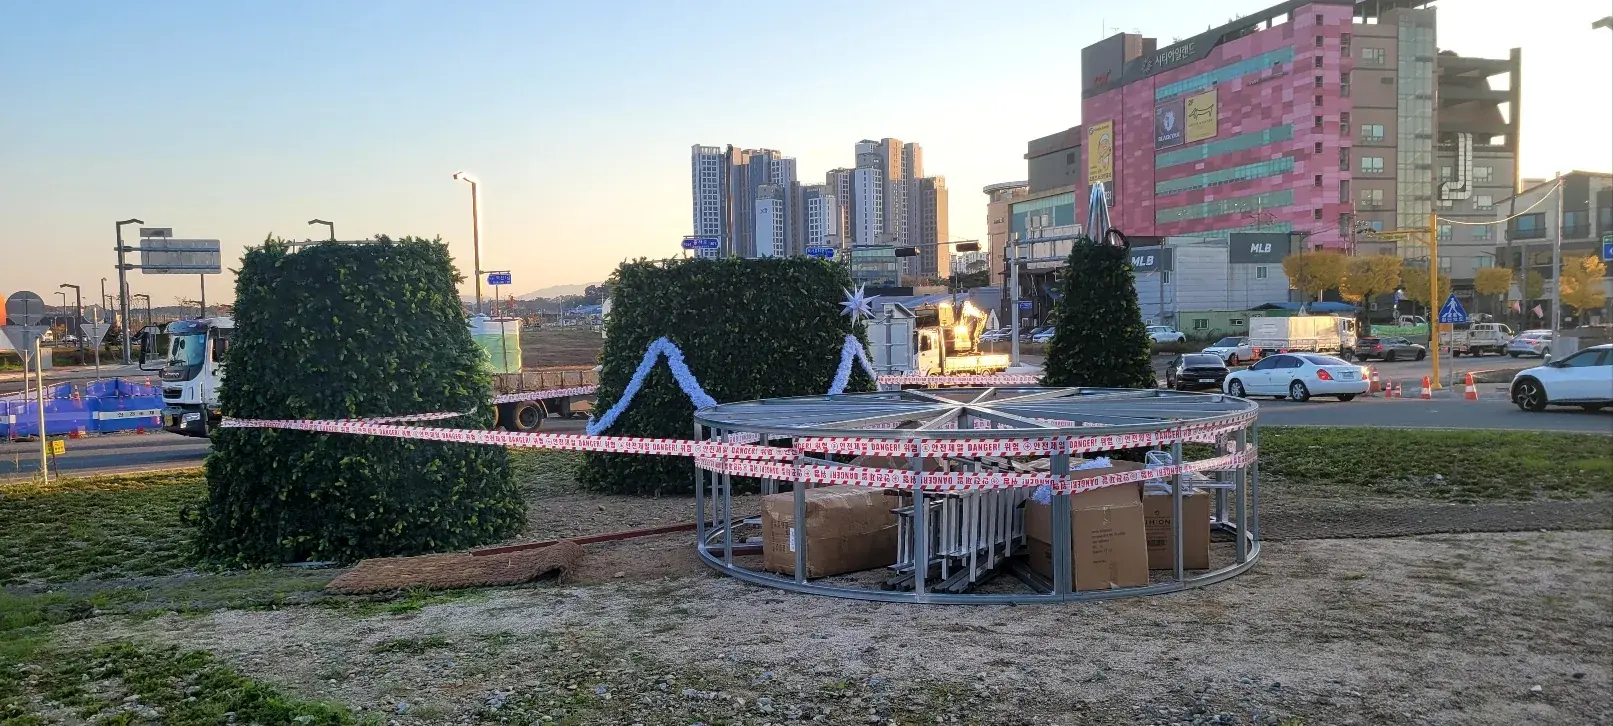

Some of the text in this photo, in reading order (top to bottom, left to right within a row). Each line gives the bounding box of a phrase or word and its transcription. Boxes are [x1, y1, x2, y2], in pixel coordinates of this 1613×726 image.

[1154, 42, 1196, 67] 시티아일랜드
[1250, 243, 1272, 253] MLB
[1131, 255, 1154, 267] MLB
[840, 442, 867, 451] 안전제일
[871, 443, 900, 452] DANGER!
[904, 444, 918, 453] 위험
[931, 443, 964, 453] 안전제일
[967, 443, 1000, 452] DANGER!
[1004, 442, 1019, 452] 위험
[1033, 441, 1066, 451] 안전제일
[1069, 439, 1098, 449] DANGER!
[1100, 437, 1113, 446] 위험
[1124, 432, 1152, 444] 안전제일
[1155, 429, 1181, 441] DANGER!
[578, 439, 602, 448] DANGER!
[604, 440, 616, 449] 위험
[625, 441, 650, 450] 안전제일
[652, 443, 678, 452] DANGER!
[680, 444, 692, 453] 위험
[702, 445, 729, 454] 안전제일
[731, 447, 758, 455] DANGER!
[814, 470, 827, 478] 위험
[830, 471, 858, 480] DANGER!
[862, 473, 890, 483] 안전제일
[903, 475, 917, 485] 위험
[920, 476, 953, 485] DANGER!
[957, 476, 989, 485] 안전제일
[1070, 478, 1099, 489] DANGER!
